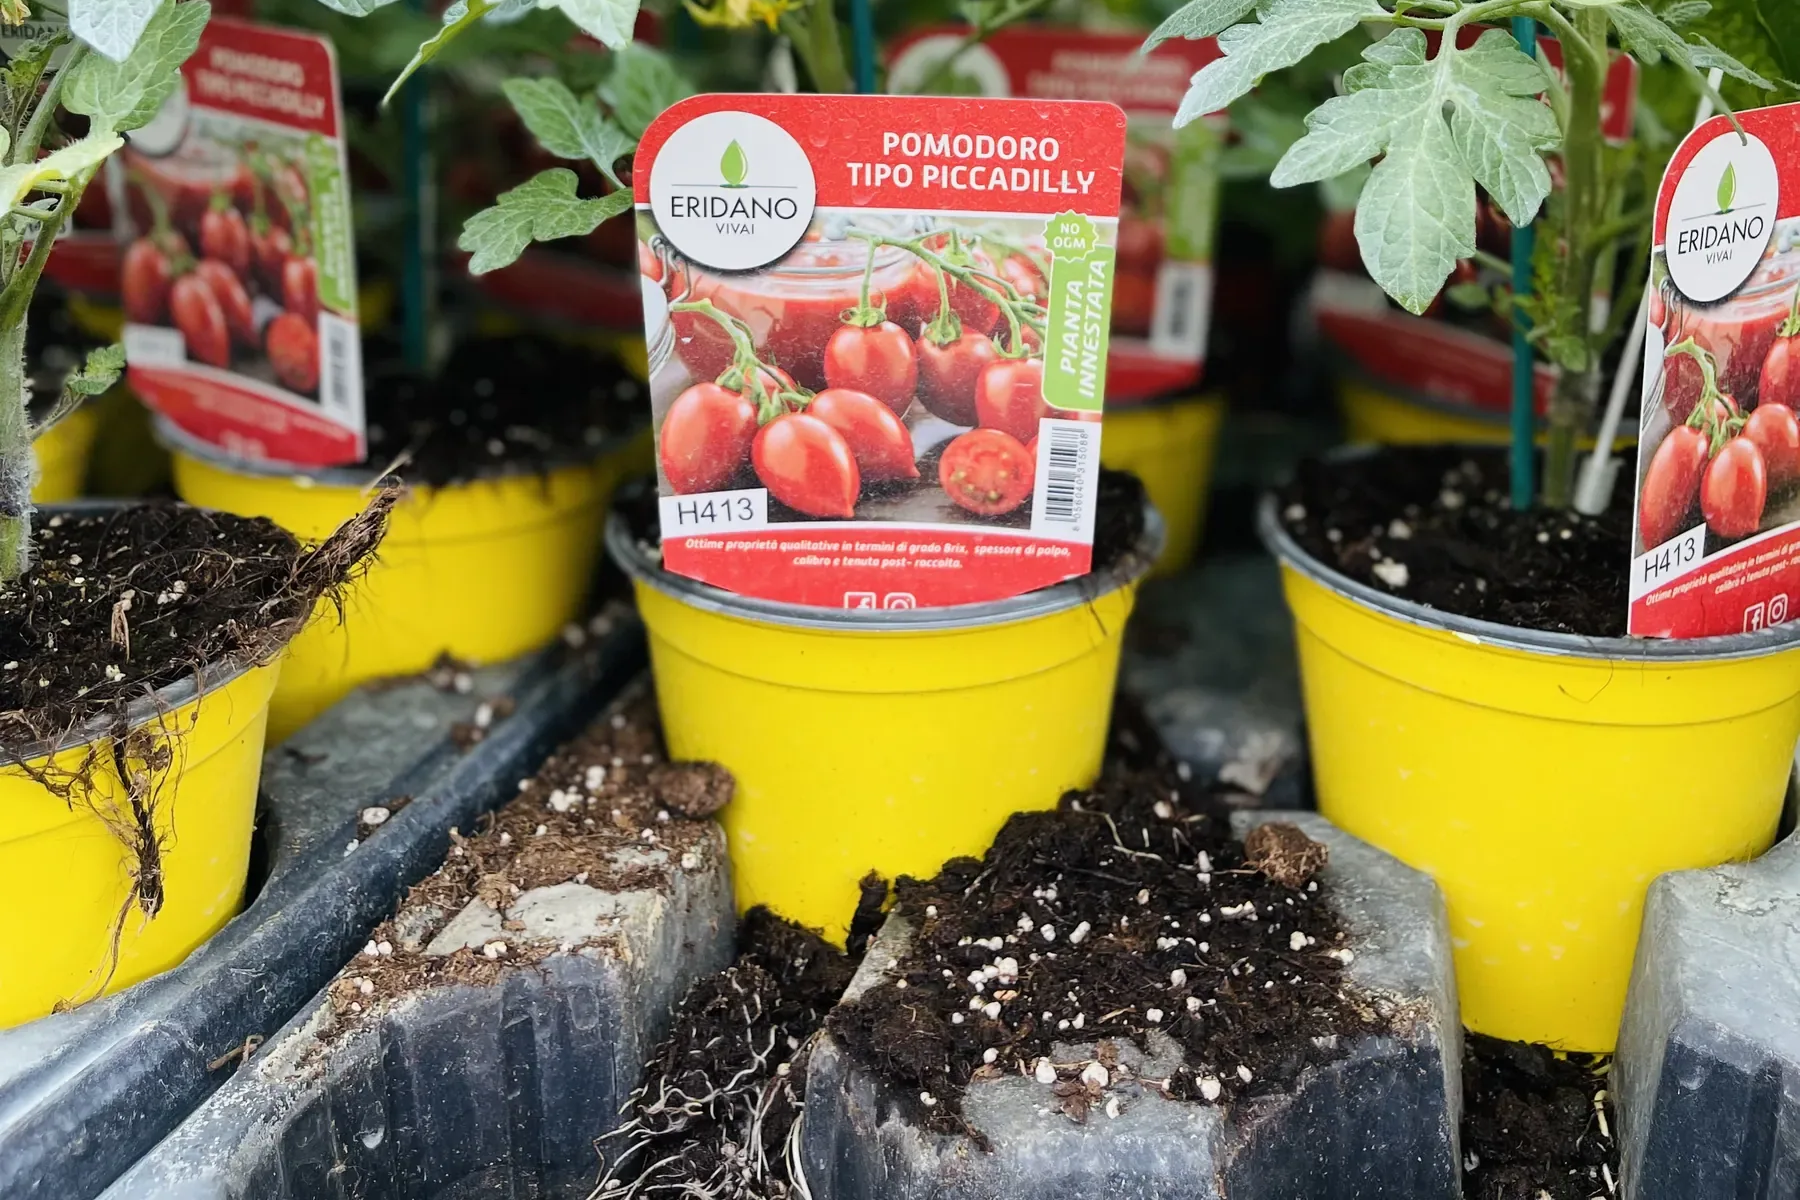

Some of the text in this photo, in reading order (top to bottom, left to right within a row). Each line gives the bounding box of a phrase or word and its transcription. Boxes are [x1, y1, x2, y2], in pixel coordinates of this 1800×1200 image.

[883, 132, 1060, 162] POMODORO
[846, 162, 1096, 194] TIPO PICCADILLY
[671, 196, 798, 220] ERIDANO
[715, 222, 755, 235] VIVAI
[1060, 222, 1080, 235] NO
[1677, 215, 1764, 255] ERIDANO
[1053, 236, 1086, 249] OGM
[1706, 249, 1733, 265] VIVAI
[1060, 280, 1085, 376] PIANTA
[1078, 259, 1109, 399] INNESTATA
[677, 497, 754, 525] H413
[685, 538, 725, 550] Ottime
[779, 540, 840, 553] qualitative
[841, 542, 853, 551] in
[855, 542, 894, 552] termini
[896, 542, 907, 552] di
[909, 543, 941, 555] grado
[974, 545, 1021, 556] spessore
[1024, 545, 1035, 555] di
[1643, 537, 1696, 583] H413
[793, 555, 831, 566] calibro
[832, 557, 839, 566] e
[842, 557, 880, 567] tenuta
